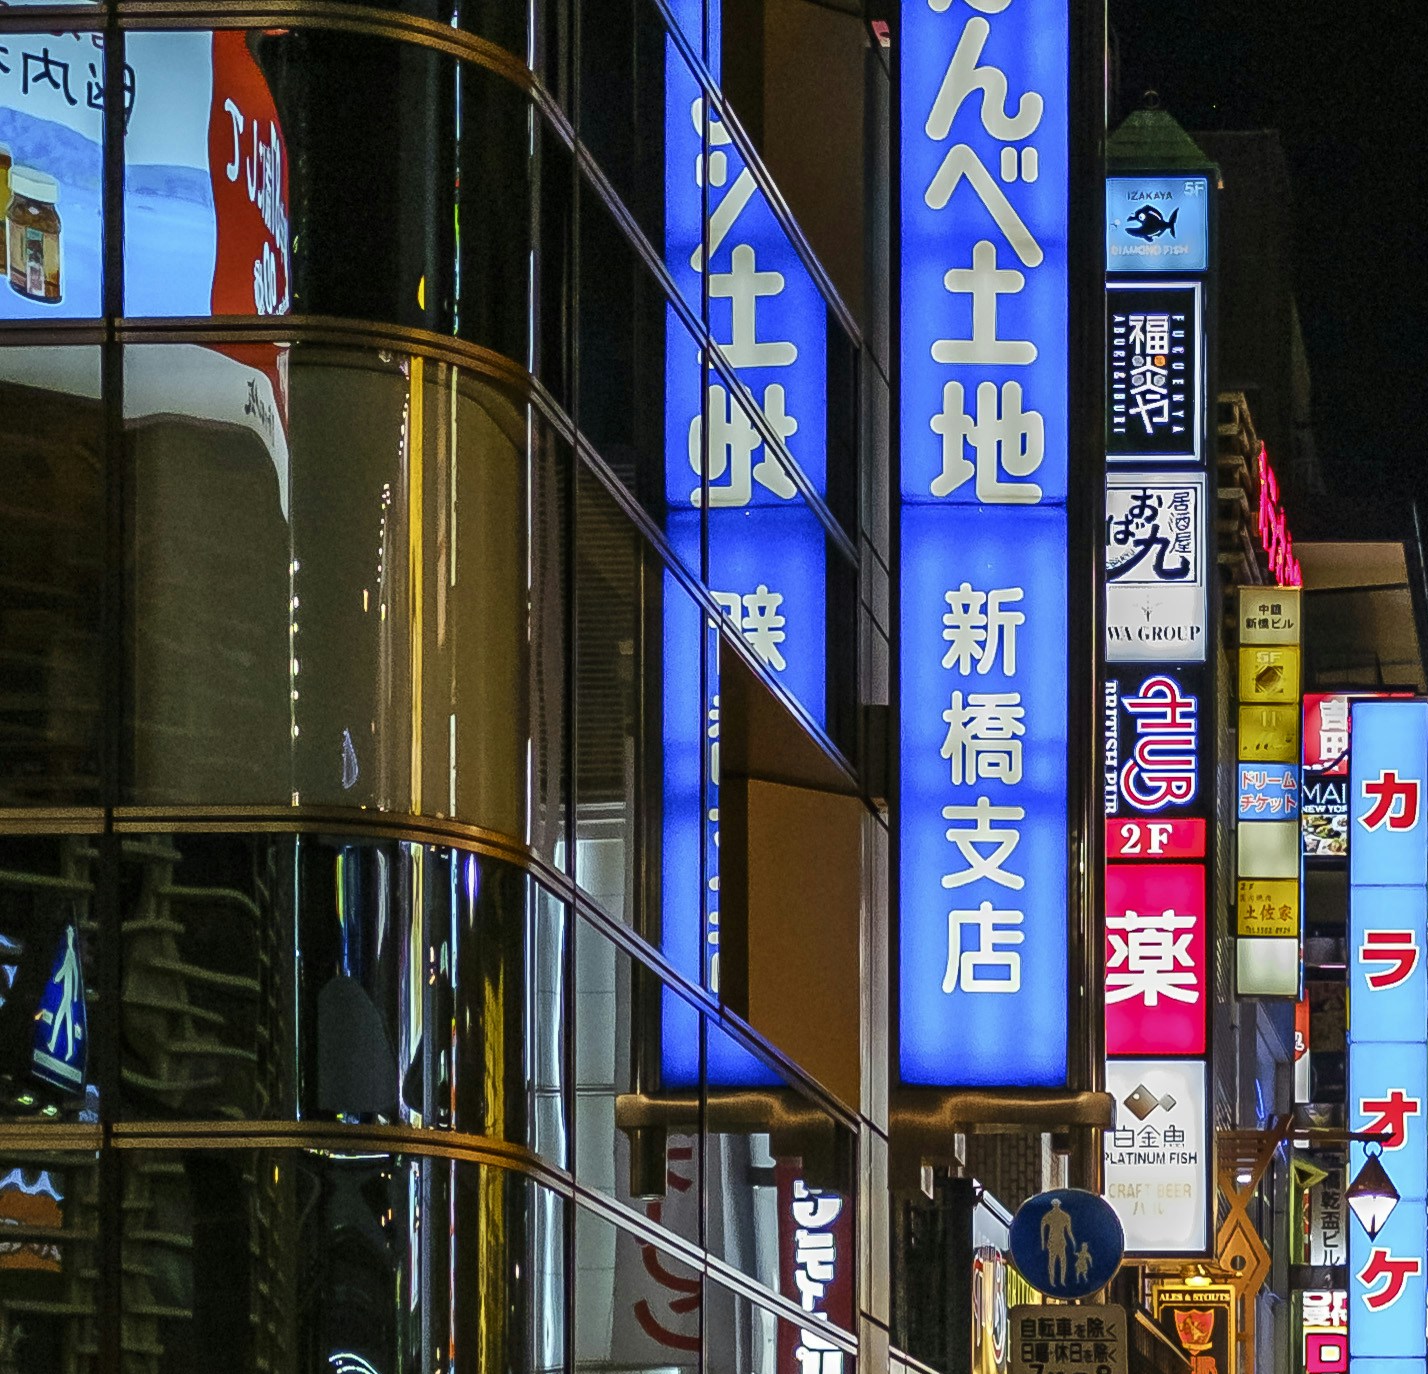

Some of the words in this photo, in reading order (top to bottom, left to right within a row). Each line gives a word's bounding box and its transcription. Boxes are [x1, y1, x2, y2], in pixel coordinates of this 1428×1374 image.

[1127, 190, 1173, 200] IZAKAYA
[924, 0, 1044, 504] んべ土地
[1138, 626, 1200, 641] GROUP
[1245, 617, 1295, 630] 新橋ビル
[1121, 676, 1198, 811] HUB
[941, 582, 1026, 993] 新橋支店
[1240, 771, 1297, 788] ドリーム
[1240, 794, 1298, 812] チケット
[1119, 822, 1172, 855] 2F
[1105, 908, 1200, 1006] 薬
[1169, 1152, 1198, 1165] FISH
[1020, 1316, 1117, 1338] 自転車を除く
